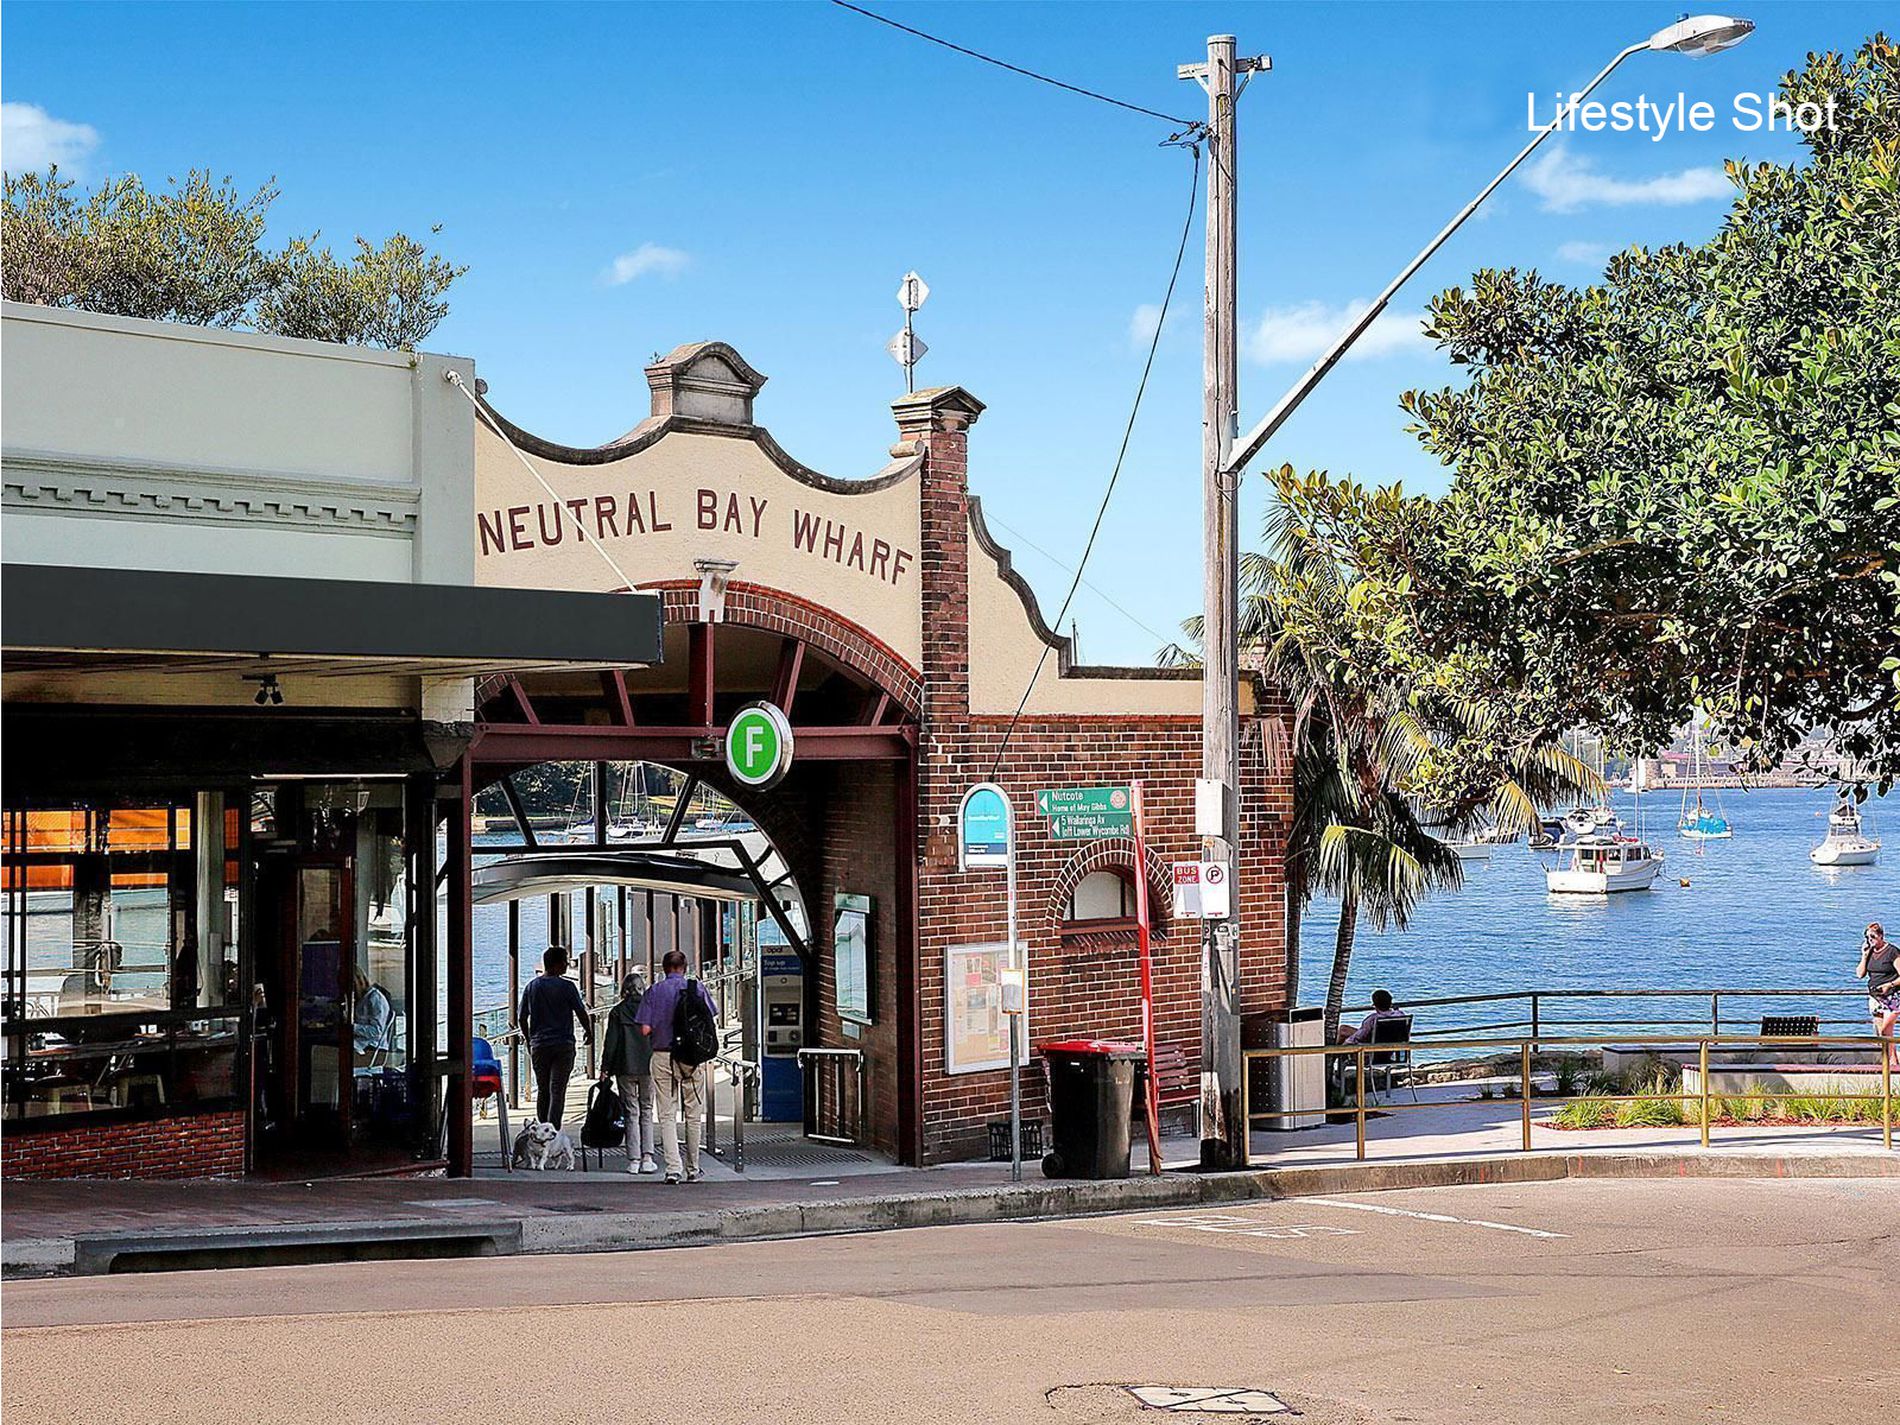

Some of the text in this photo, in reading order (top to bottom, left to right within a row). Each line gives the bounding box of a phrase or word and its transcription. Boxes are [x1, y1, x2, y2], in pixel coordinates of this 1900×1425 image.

[477, 488, 914, 586] NEUTRAL BAY WHARF
[746, 726, 763, 768] F
[1052, 791, 1084, 801] Nutcote
[1077, 804, 1090, 812] May
[1092, 802, 1107, 810] Gibbs
[1061, 815, 1066, 825] 5
[1073, 825, 1091, 837] Lower
[1092, 825, 1119, 837] Wycombe
[1176, 867, 1197, 875] BUS
